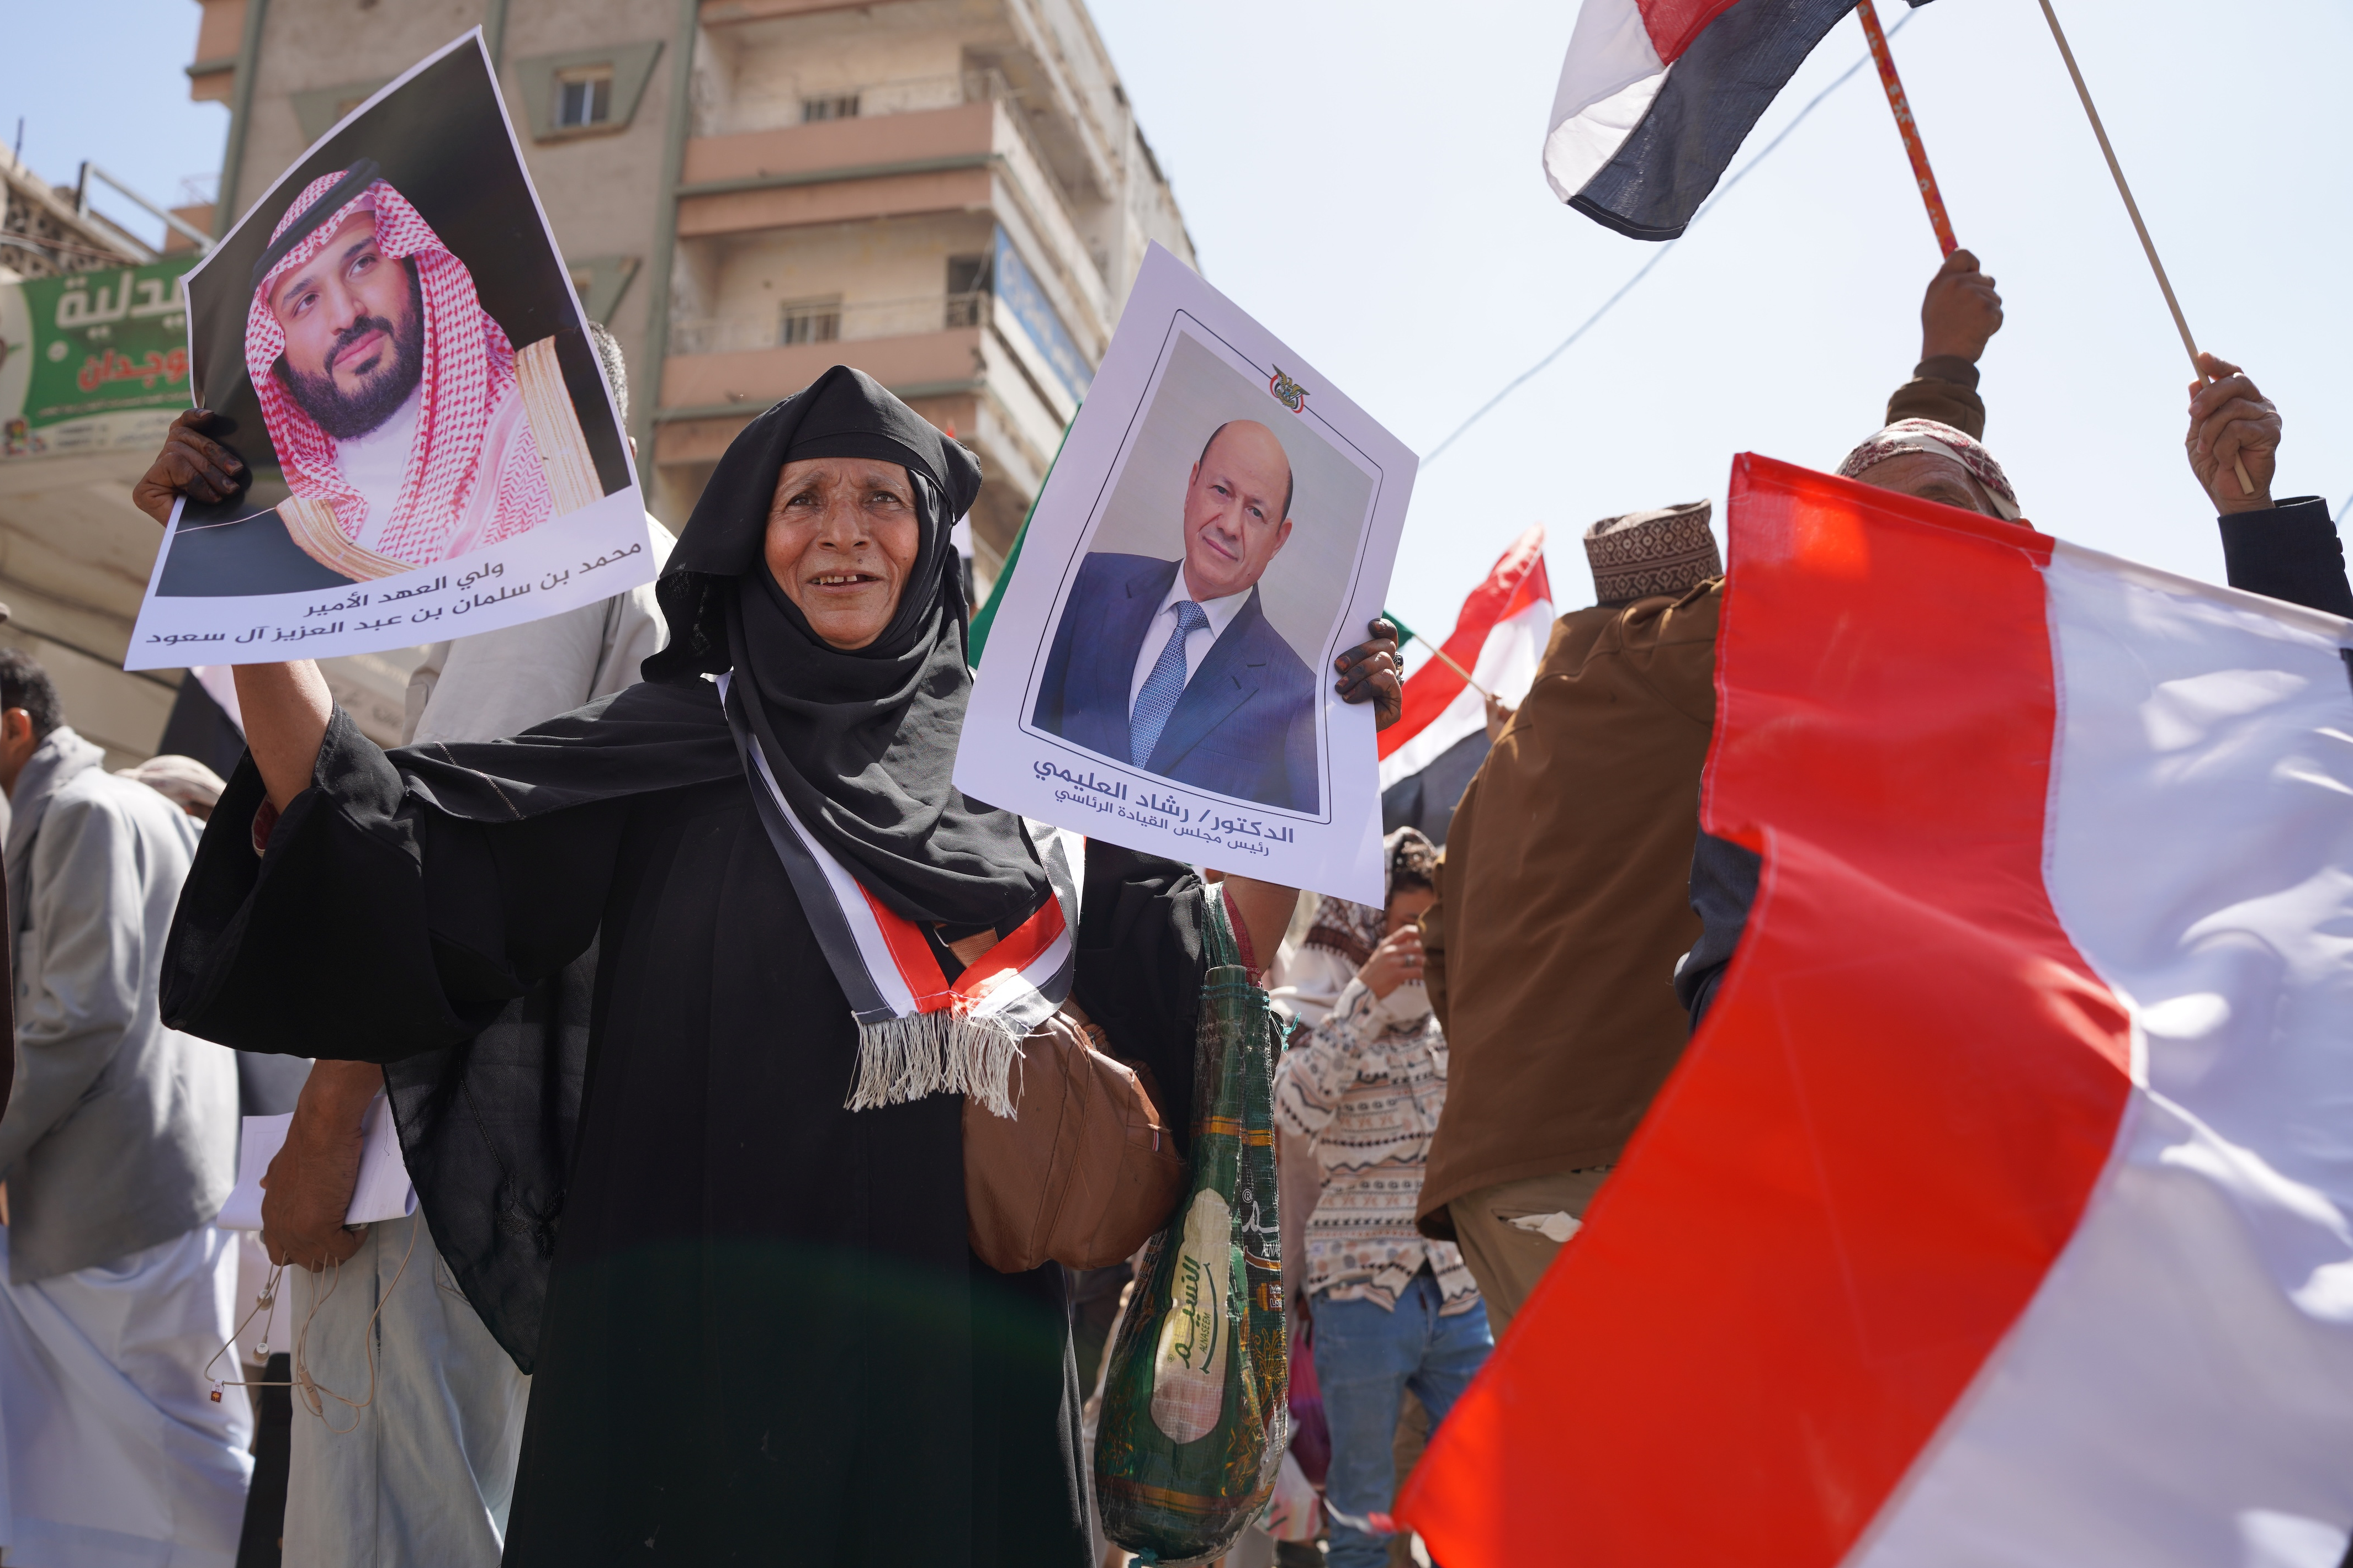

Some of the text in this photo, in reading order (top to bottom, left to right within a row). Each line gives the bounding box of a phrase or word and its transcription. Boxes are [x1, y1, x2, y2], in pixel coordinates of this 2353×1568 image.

[55, 272, 188, 340] يدلية
[78, 347, 189, 390] وجدان
[146, 543, 642, 646] محمد بن سلمان بن عبد العزيز آل سعود
[303, 561, 505, 617] ولي العهد الأمير
[1033, 759, 1127, 801] العليمي
[1054, 787, 1269, 857] رئيس مجلس القيادة الرئاسي
[1136, 793, 1189, 823] رشاد
[1199, 1312, 1211, 1354] ALNASEEM
